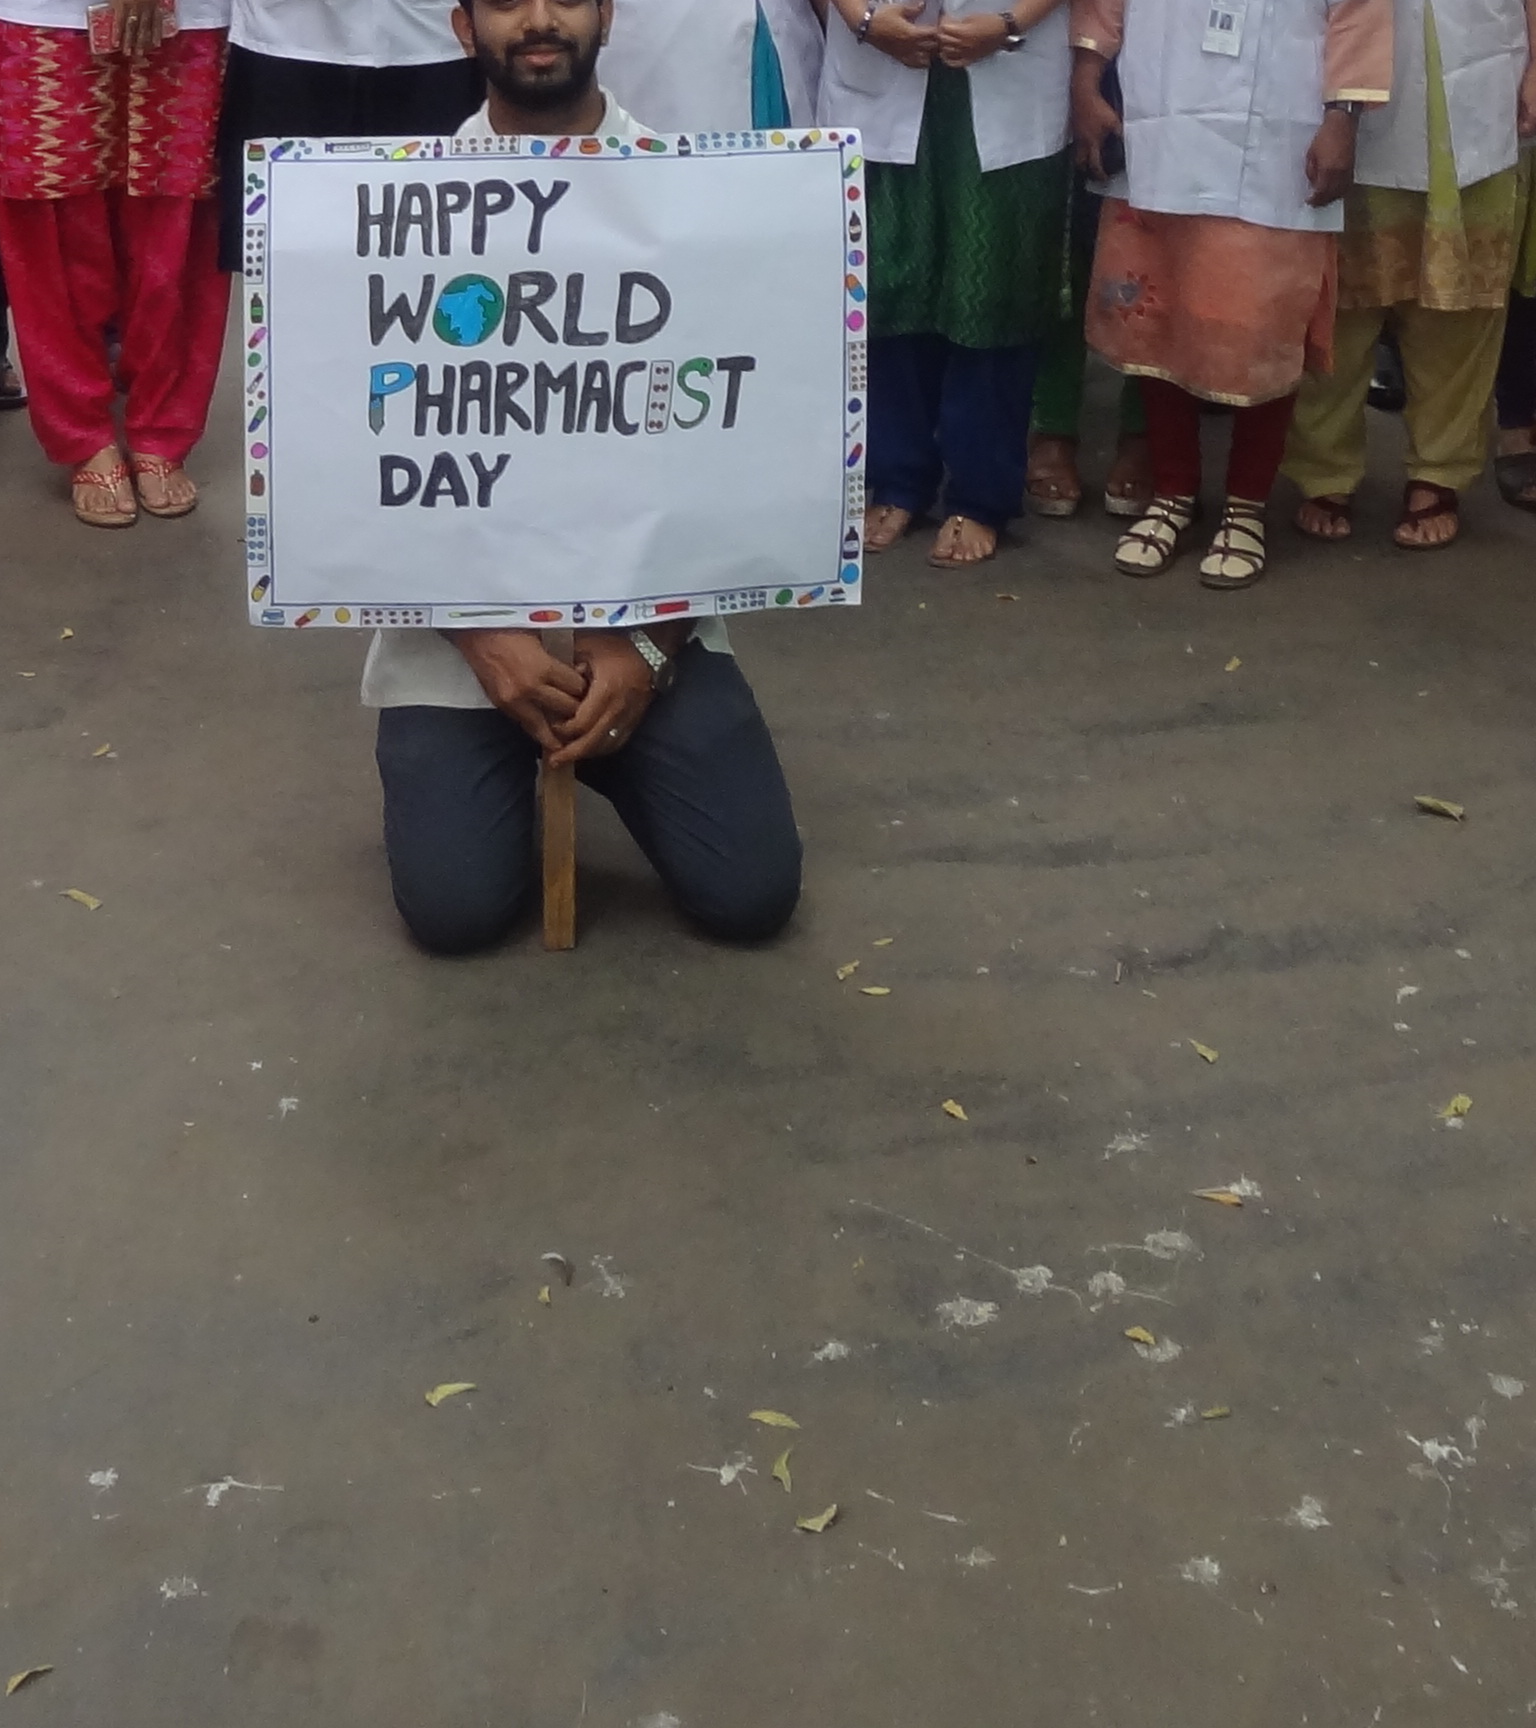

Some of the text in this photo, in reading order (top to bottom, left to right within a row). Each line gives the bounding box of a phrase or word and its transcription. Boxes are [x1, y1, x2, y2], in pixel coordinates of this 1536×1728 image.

[356, 178, 571, 260] HAPPY
[368, 270, 673, 348] WORLD
[369, 355, 757, 438] PHARMACIST
[379, 451, 512, 509] DAY
